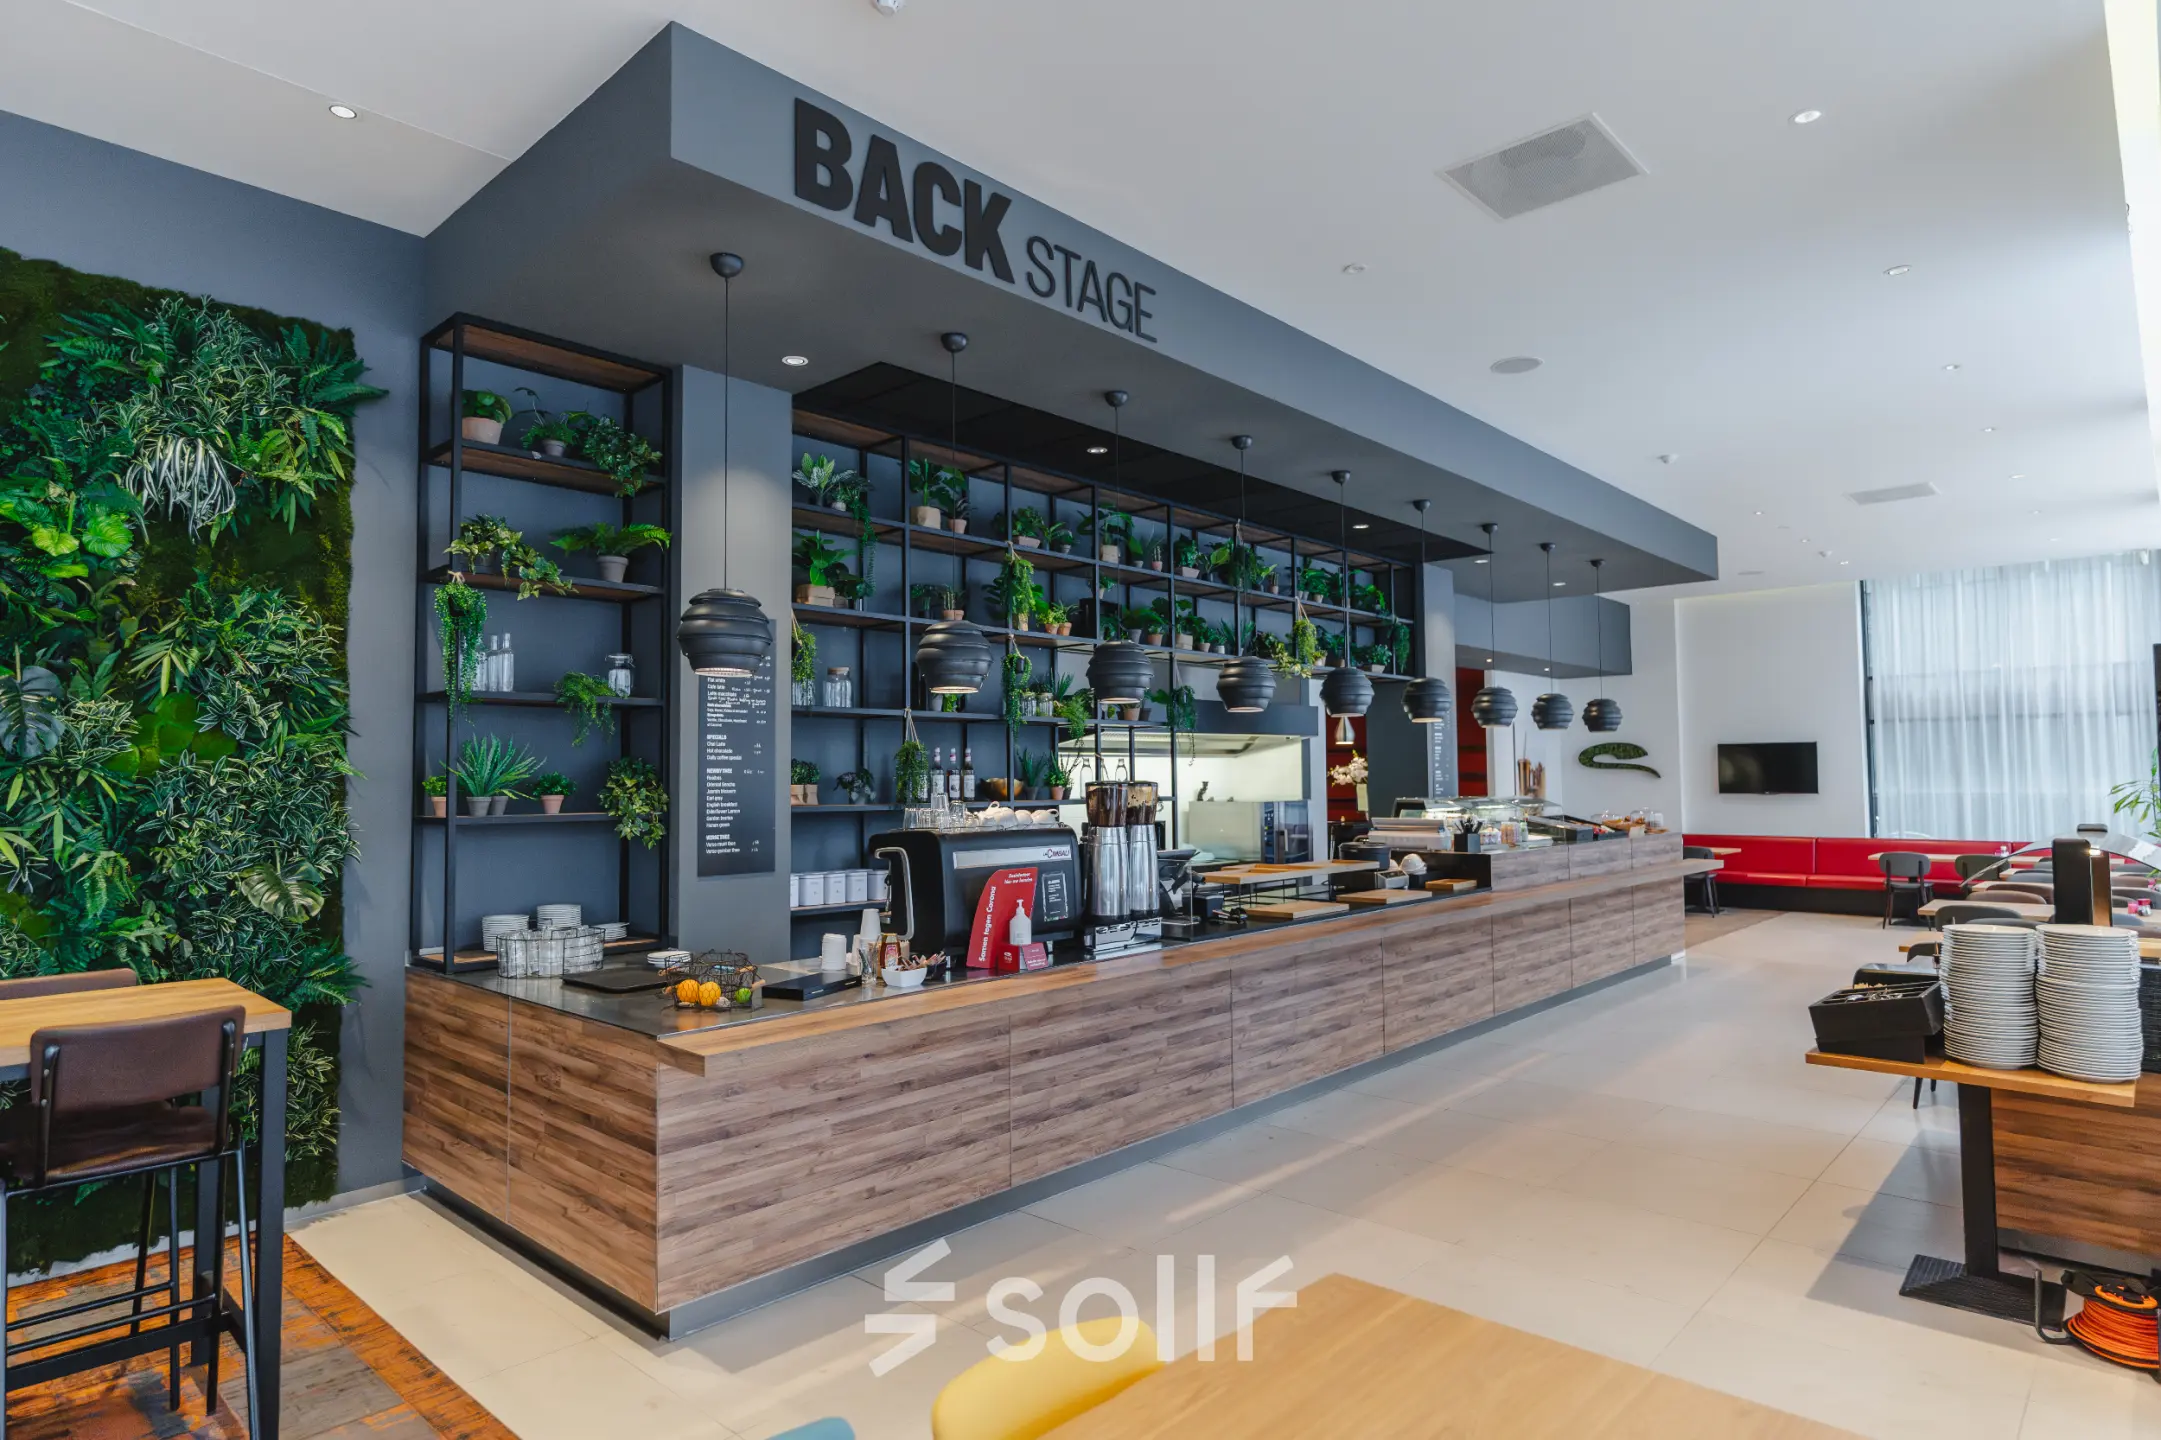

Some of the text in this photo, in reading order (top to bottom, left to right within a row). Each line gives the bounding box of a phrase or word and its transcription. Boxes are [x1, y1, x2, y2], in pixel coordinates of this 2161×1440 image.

[794, 97, 1158, 343] BACK STAGE
[978, 886, 996, 962] Samen tegen Corona
